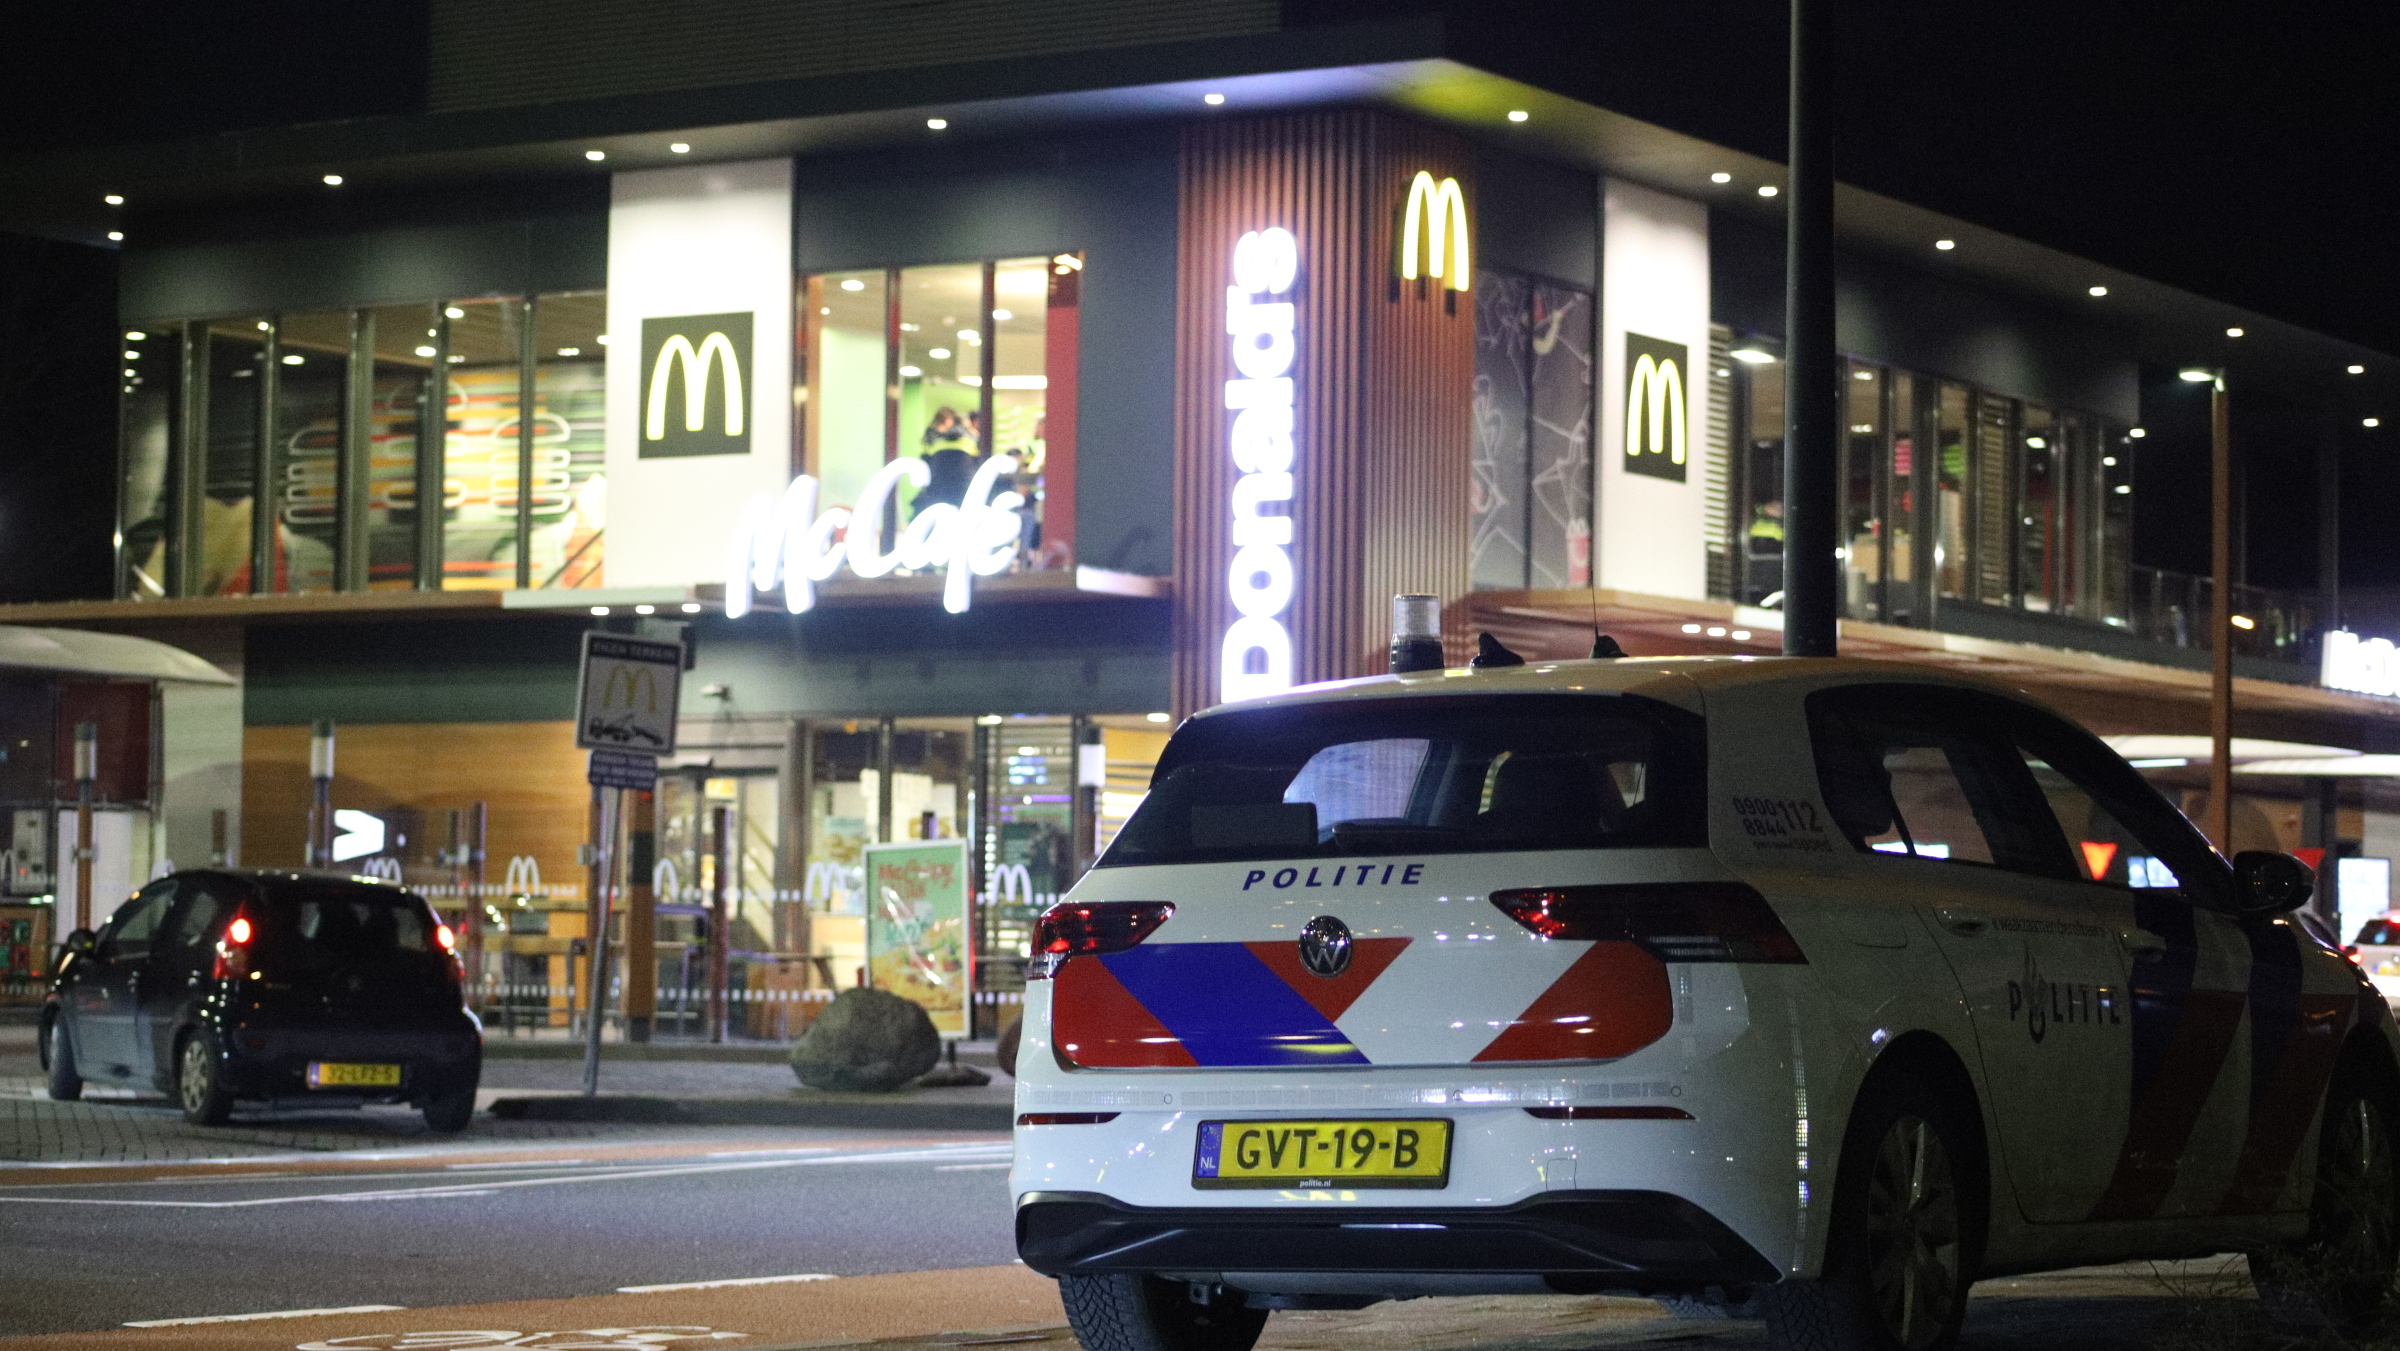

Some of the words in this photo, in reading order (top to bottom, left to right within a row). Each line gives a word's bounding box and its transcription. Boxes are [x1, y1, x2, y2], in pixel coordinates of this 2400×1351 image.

[1732, 796, 1777, 817] 0900
[1777, 800, 1823, 832] 112
[1742, 817, 1787, 836] 8844
[1242, 864, 1425, 891] POLITIE
[2007, 980, 2120, 1043] POLITIE
[1236, 1128, 1420, 1170] GVT-19-B
[1200, 1156, 1216, 1169] NL
[1299, 1178, 1331, 1188] politie.nl
